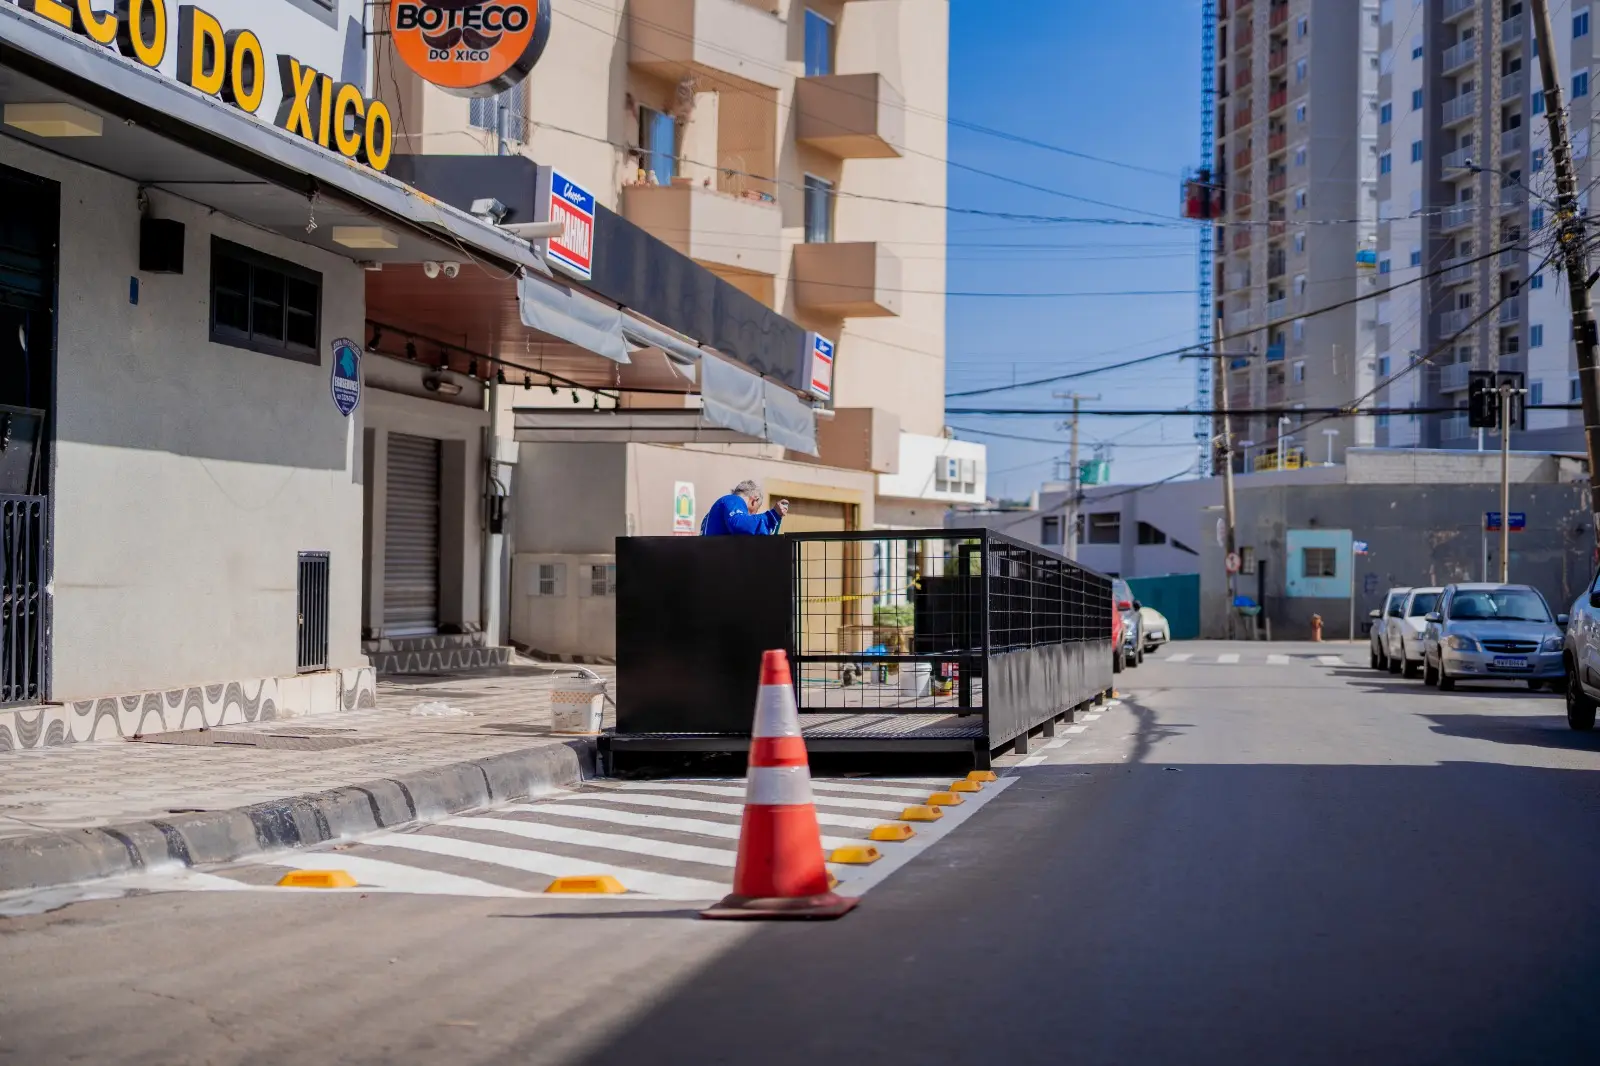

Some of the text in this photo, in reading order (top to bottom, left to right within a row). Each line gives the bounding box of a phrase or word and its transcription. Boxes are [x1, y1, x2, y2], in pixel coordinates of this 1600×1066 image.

[397, 5, 529, 31] BOTECO
[429, 50, 489, 61] DO XICO
[181, 6, 265, 113] DO
[278, 55, 392, 171] XICO
